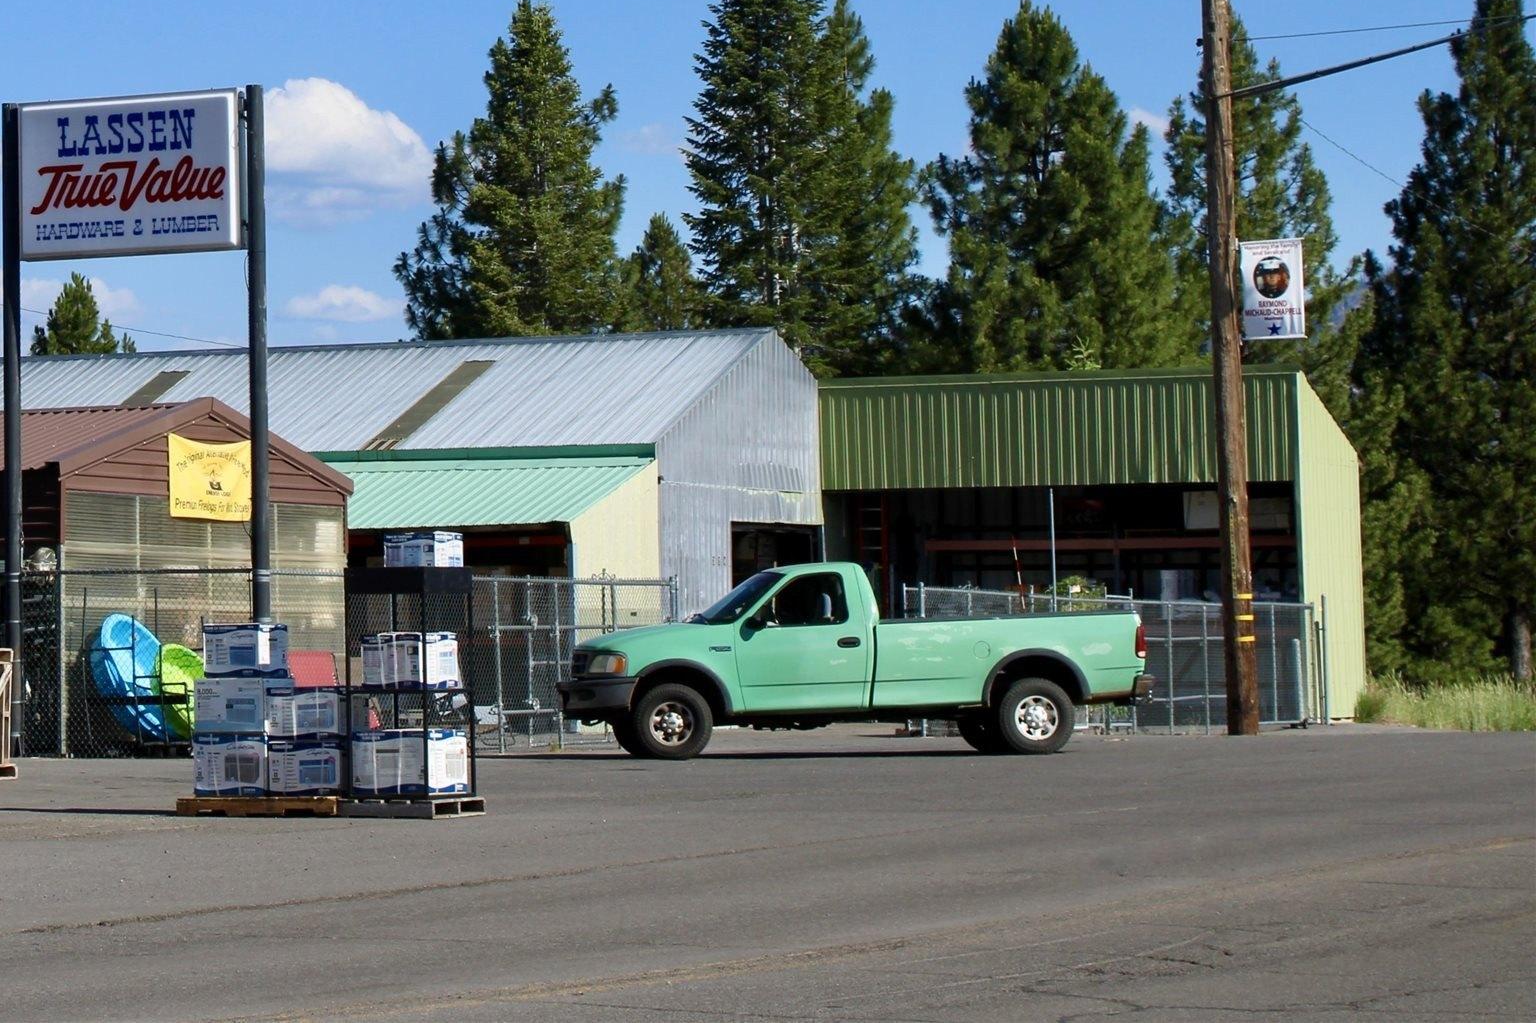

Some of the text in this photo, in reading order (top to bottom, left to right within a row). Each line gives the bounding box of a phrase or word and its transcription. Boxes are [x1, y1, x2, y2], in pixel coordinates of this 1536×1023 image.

[57, 108, 195, 158] LASSEN
[36, 214, 220, 241] HARDWARE & LUMBER
